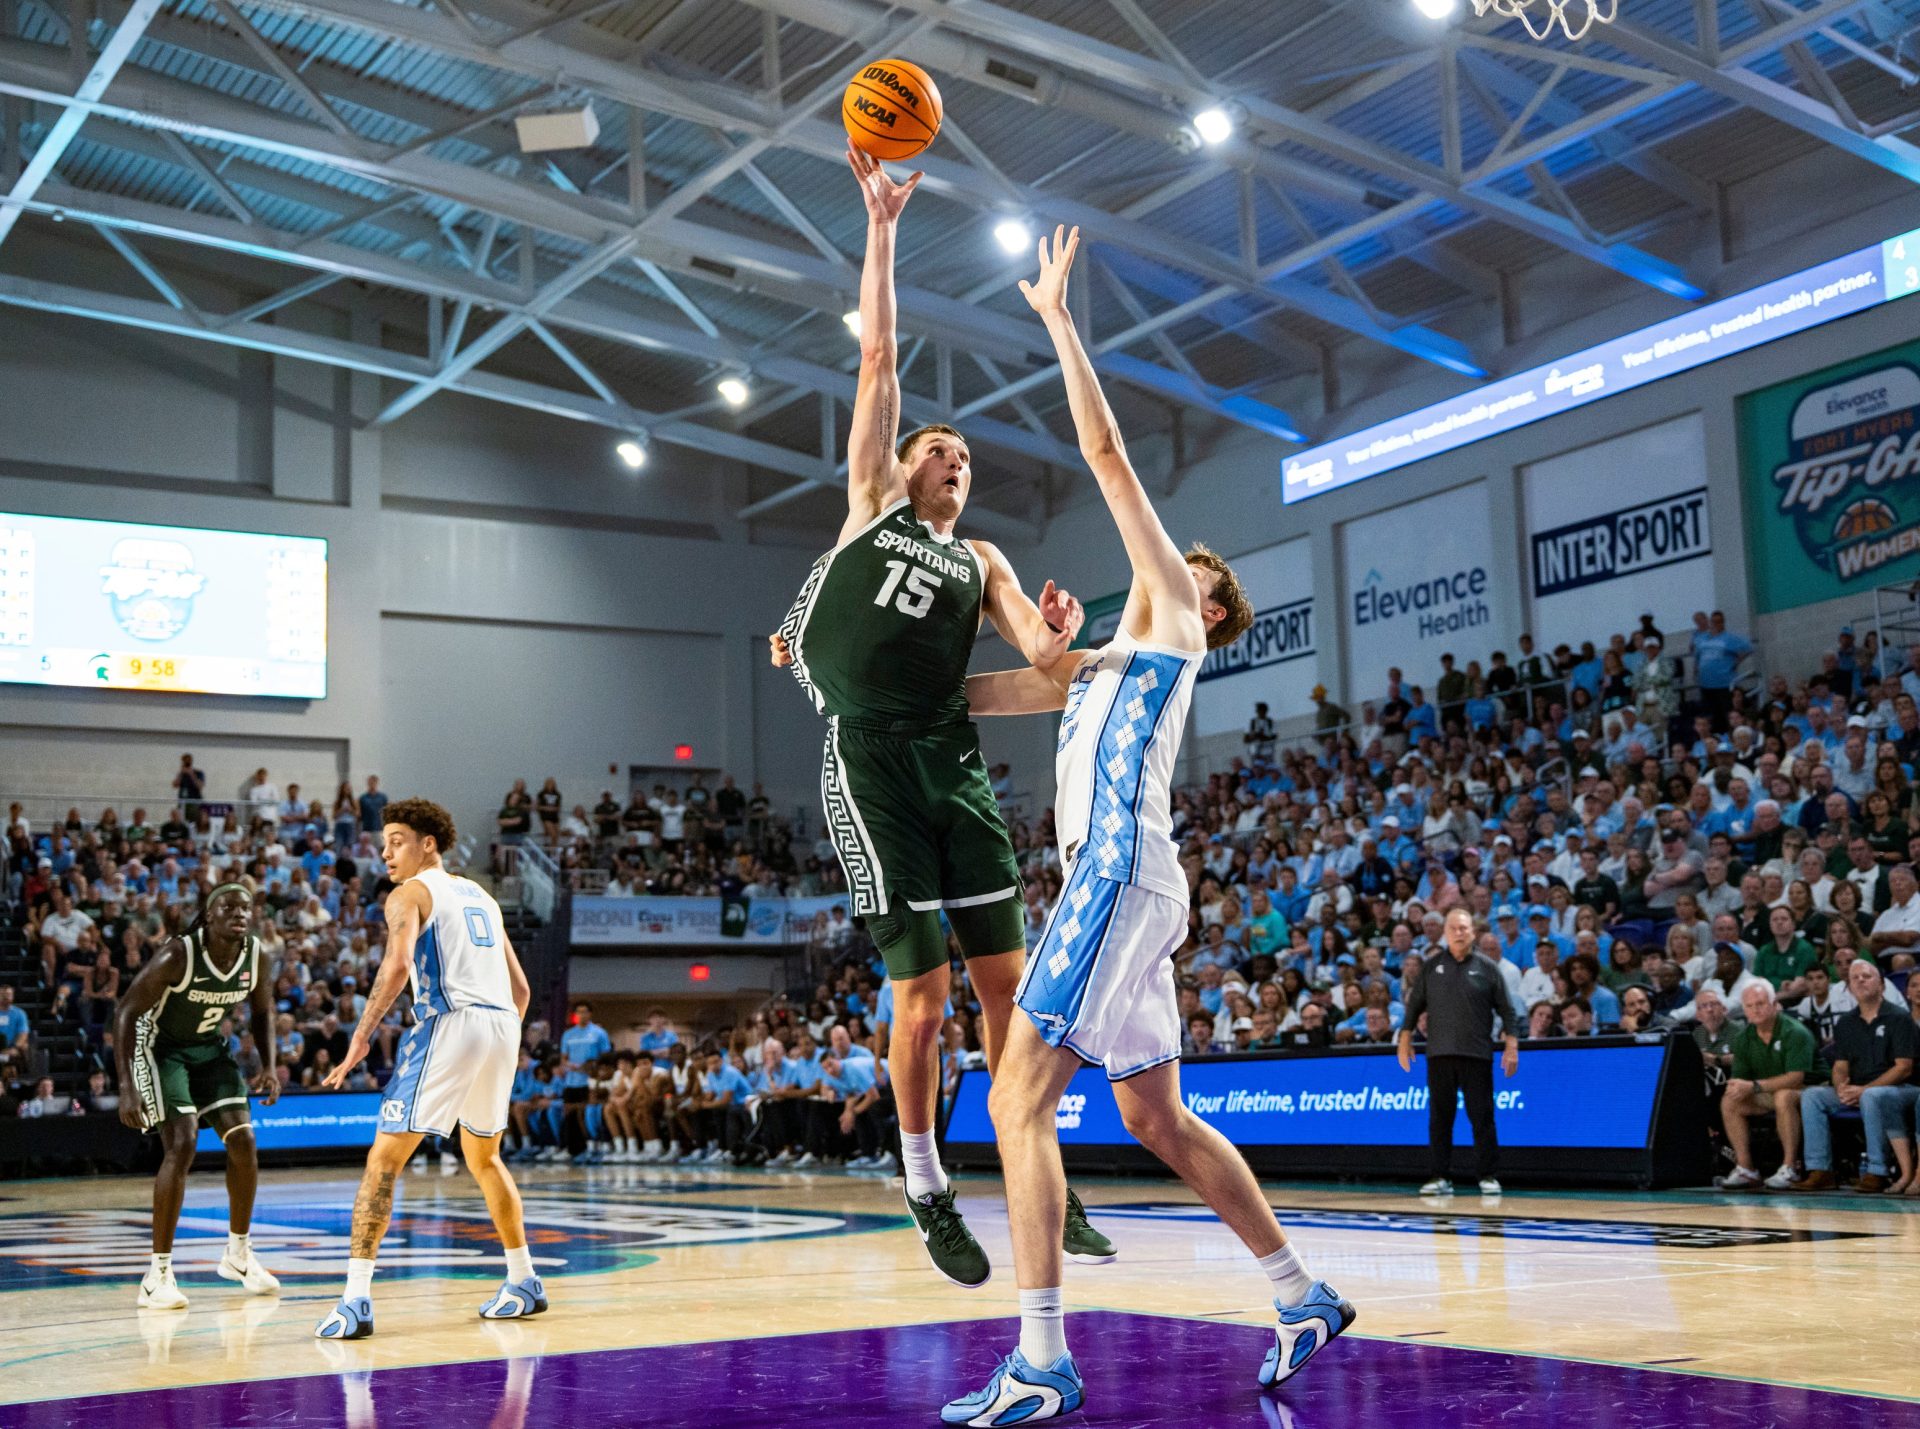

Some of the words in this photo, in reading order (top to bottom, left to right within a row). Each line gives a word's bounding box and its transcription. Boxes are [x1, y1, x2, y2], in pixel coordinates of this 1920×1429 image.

[863, 67, 919, 109] Wilson
[854, 95, 898, 128] NCAA
[1711, 306, 1763, 338] trusted
[1764, 290, 1812, 320] health
[1814, 271, 1877, 306] partner.
[1826, 387, 1888, 415] Elevance
[1804, 432, 1847, 455] FORT
[1854, 411, 1914, 441] MYERS
[873, 529, 971, 583] SPARTANS
[873, 560, 943, 619] 15
[1355, 567, 1487, 626] Elevance
[1419, 600, 1490, 639] Health
[464, 906, 495, 948] 0
[187, 989, 249, 1004] SPARTANS
[196, 1007, 225, 1034] 2
[1188, 1093, 1225, 1113] Your
[1225, 1090, 1295, 1114] lifetime,
[1299, 1087, 1368, 1111] trusted
